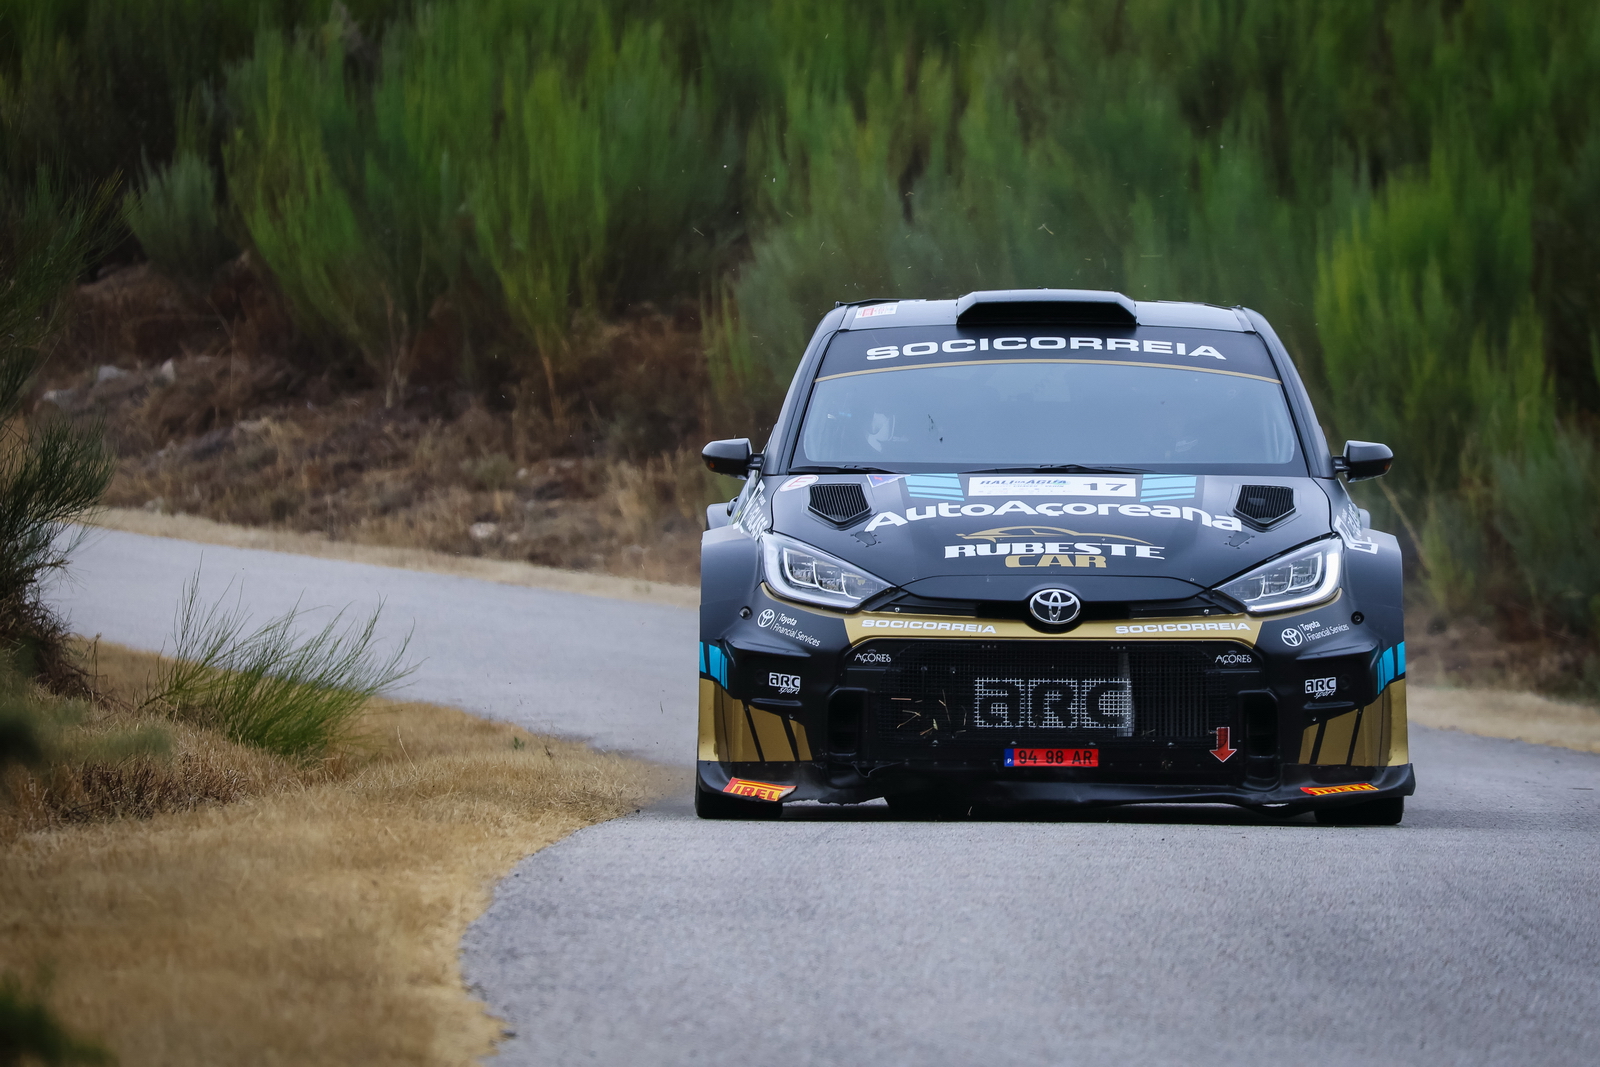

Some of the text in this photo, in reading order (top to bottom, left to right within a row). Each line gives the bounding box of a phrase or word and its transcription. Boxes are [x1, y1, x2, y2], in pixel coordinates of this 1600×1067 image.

[866, 336, 1227, 361] SOCICORREIA
[1083, 482, 1128, 491] 17
[864, 500, 1242, 532] AutoAçoreana
[944, 542, 1166, 560] RUBESTE
[1005, 554, 1107, 568] CAR
[779, 613, 798, 626] Toyota
[861, 619, 997, 634] SOCICORREIA
[1300, 620, 1321, 632] Toyota
[773, 622, 821, 647] Financial Services
[1115, 622, 1251, 634] SOCICORREIA
[1307, 623, 1350, 641] Financial Services
[854, 652, 892, 664] AÇORES
[1215, 654, 1252, 665] AÇORES
[1018, 750, 1093, 765] 94 98 AR
